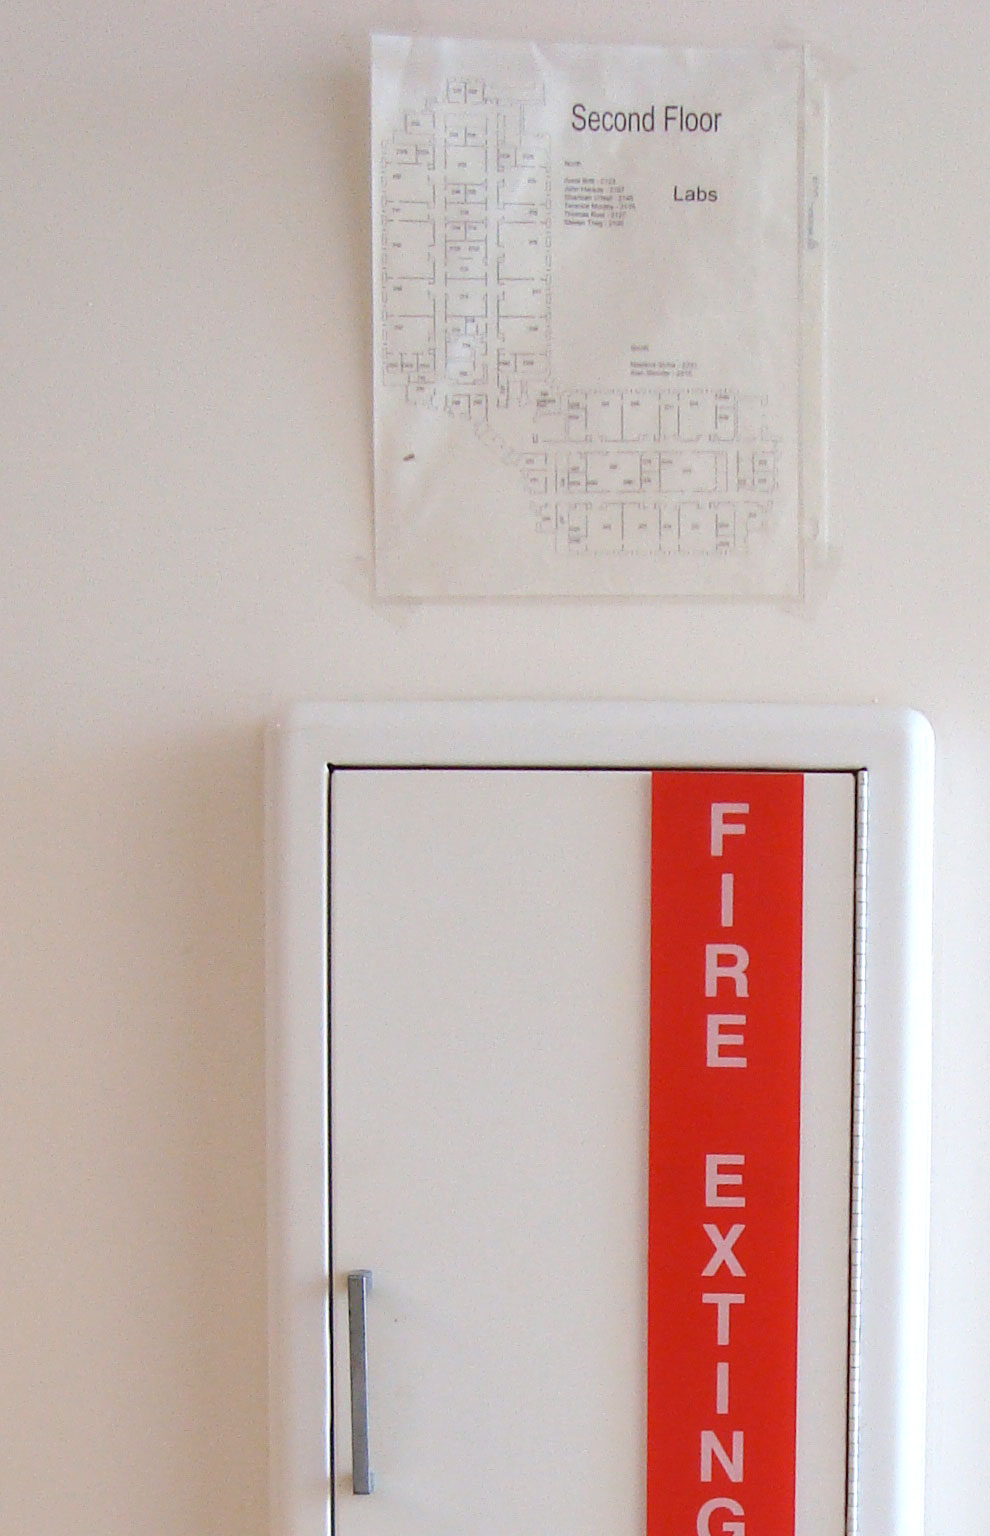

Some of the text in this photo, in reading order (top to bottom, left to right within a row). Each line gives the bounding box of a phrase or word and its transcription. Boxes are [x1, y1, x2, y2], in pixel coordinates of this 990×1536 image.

[571, 103, 722, 132] Second Floor
[673, 185, 718, 202] Labs
[704, 802, 751, 1068] FIRE
